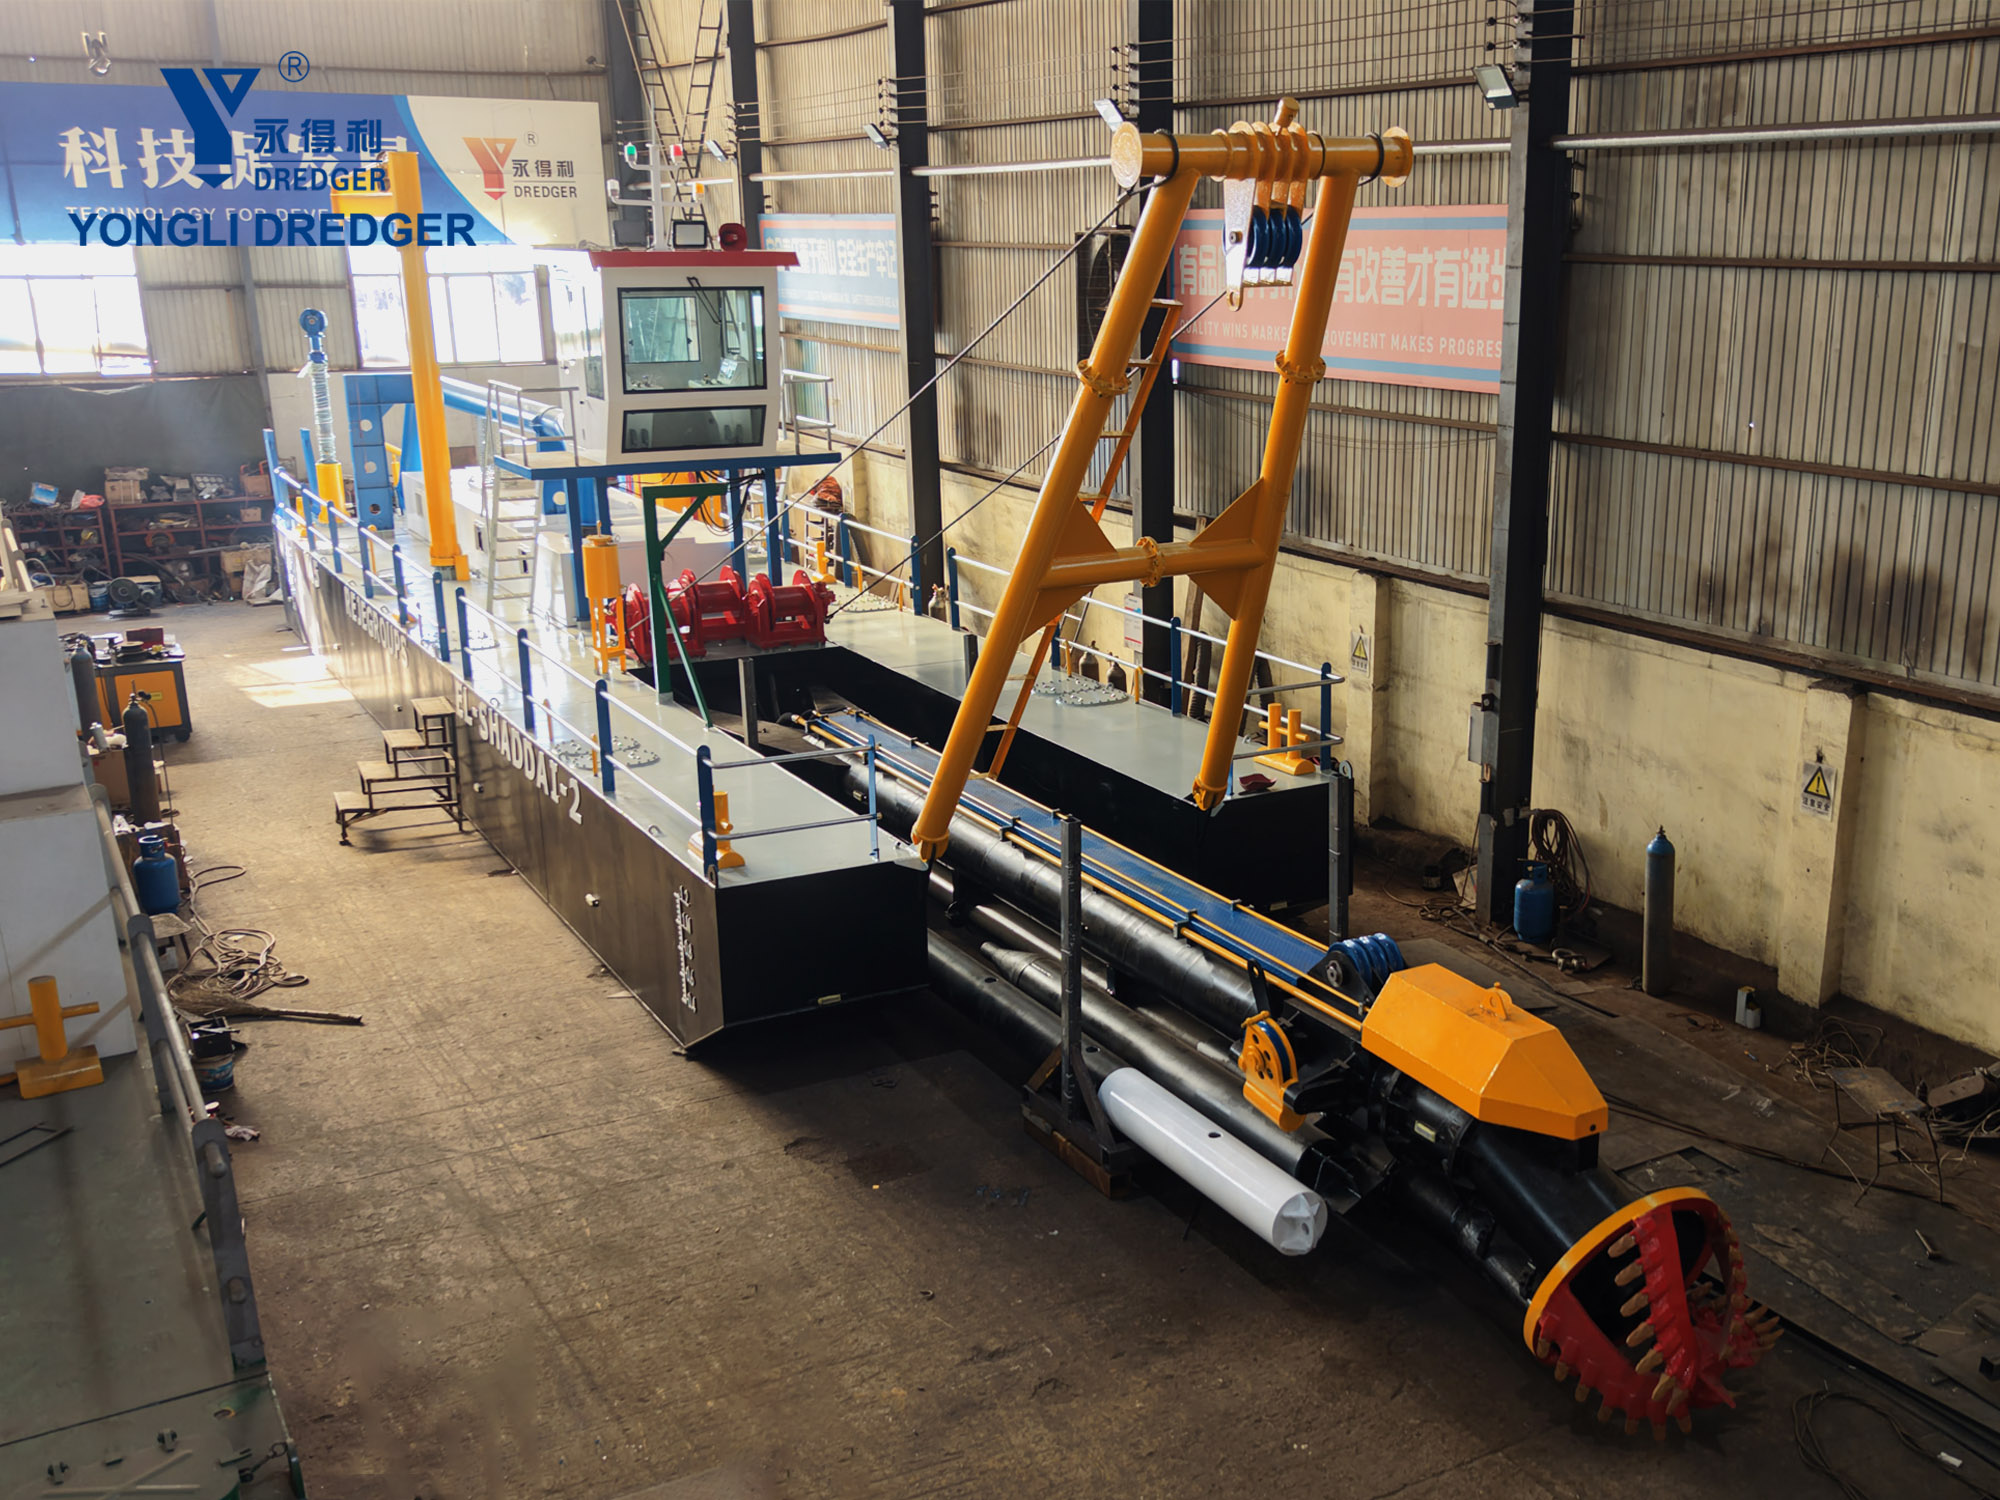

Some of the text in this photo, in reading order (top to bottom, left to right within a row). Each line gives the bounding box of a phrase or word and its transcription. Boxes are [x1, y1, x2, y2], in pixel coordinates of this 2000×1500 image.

[511, 158, 575, 178] 永得利
[514, 185, 578, 199] DREDGER
[1179, 319, 1502, 358] QUALITY WINS MARKE ROVEMENT MAKES PROGRES
[454, 679, 583, 825] EL-SHADDAI-2
